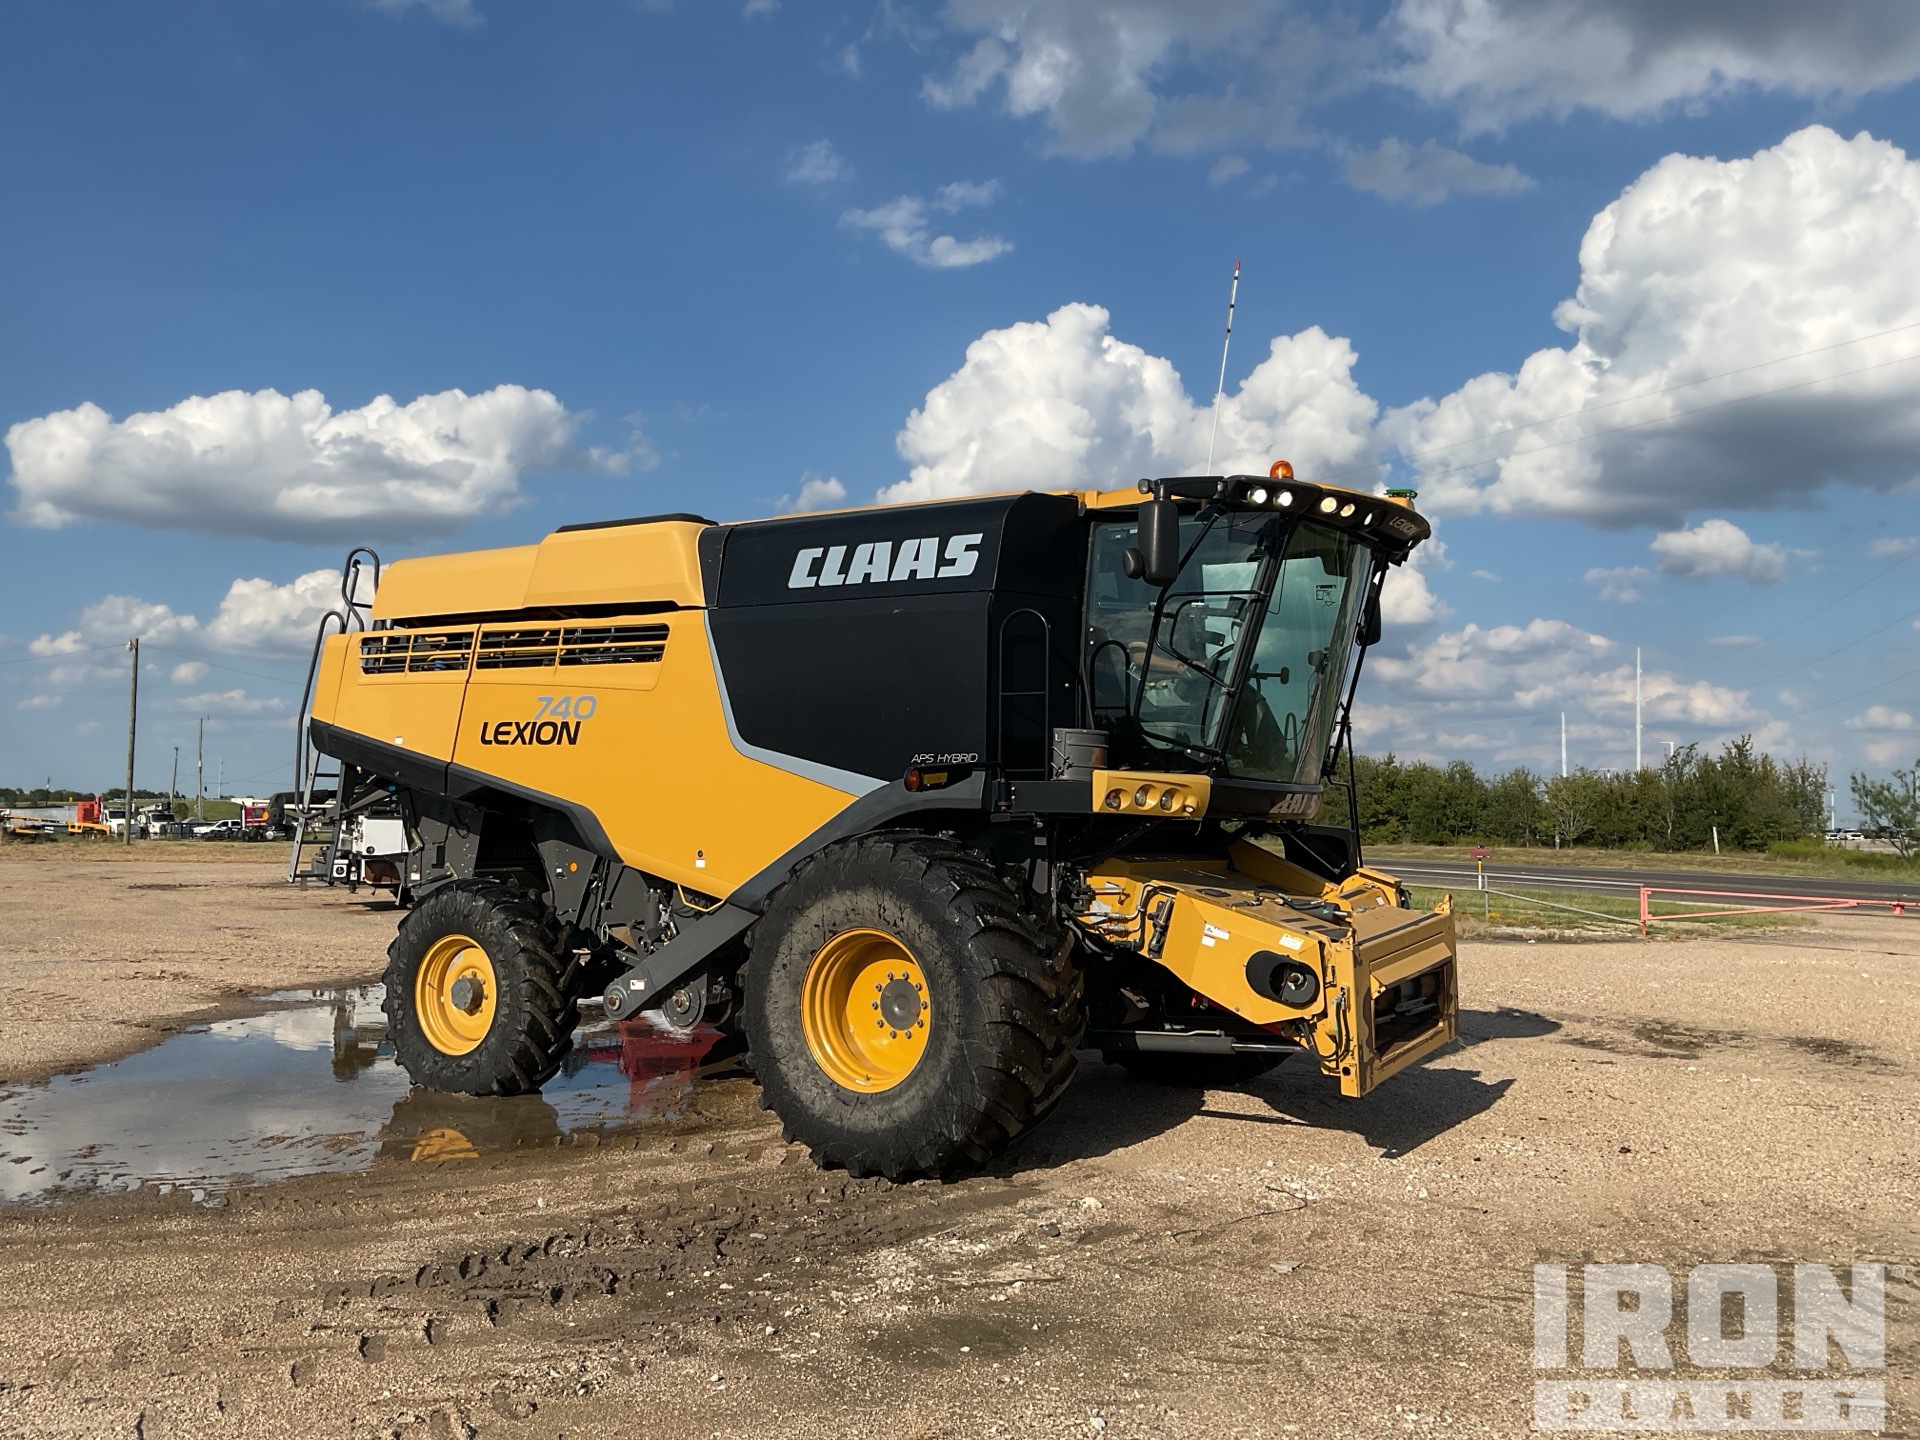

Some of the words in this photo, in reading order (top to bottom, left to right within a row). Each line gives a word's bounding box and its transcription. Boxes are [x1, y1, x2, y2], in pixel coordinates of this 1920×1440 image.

[787, 533, 983, 589] CLAAS
[534, 694, 598, 721] 740
[480, 721, 581, 745] LEXION
[910, 753, 935, 764] APS
[936, 752, 979, 764] HYBRID
